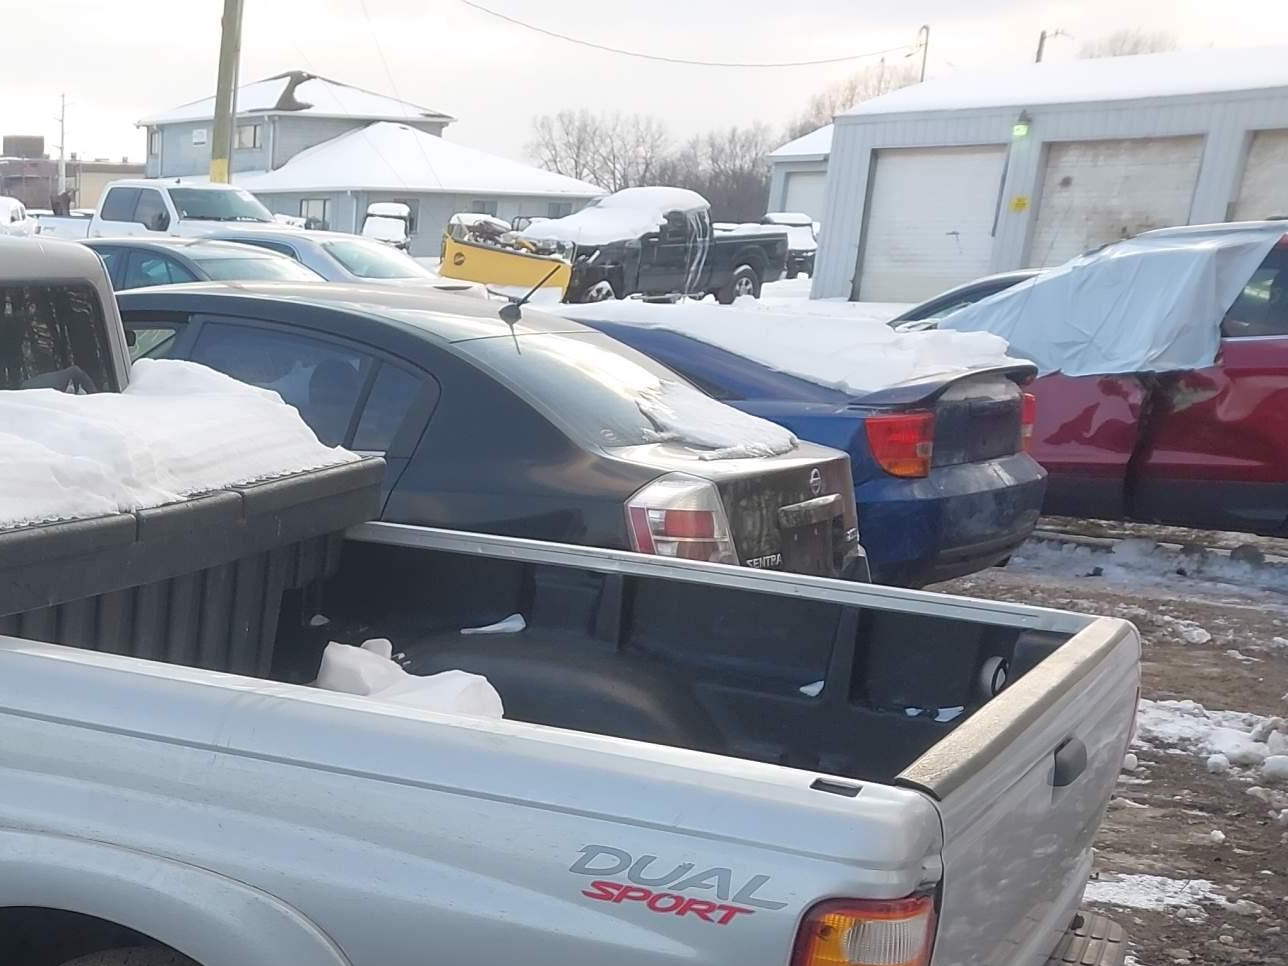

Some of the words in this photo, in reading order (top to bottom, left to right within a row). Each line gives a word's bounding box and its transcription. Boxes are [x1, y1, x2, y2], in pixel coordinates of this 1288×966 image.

[746, 553, 782, 569] SENTRA
[569, 844, 788, 910] DUAL
[581, 880, 755, 925] SPORT
